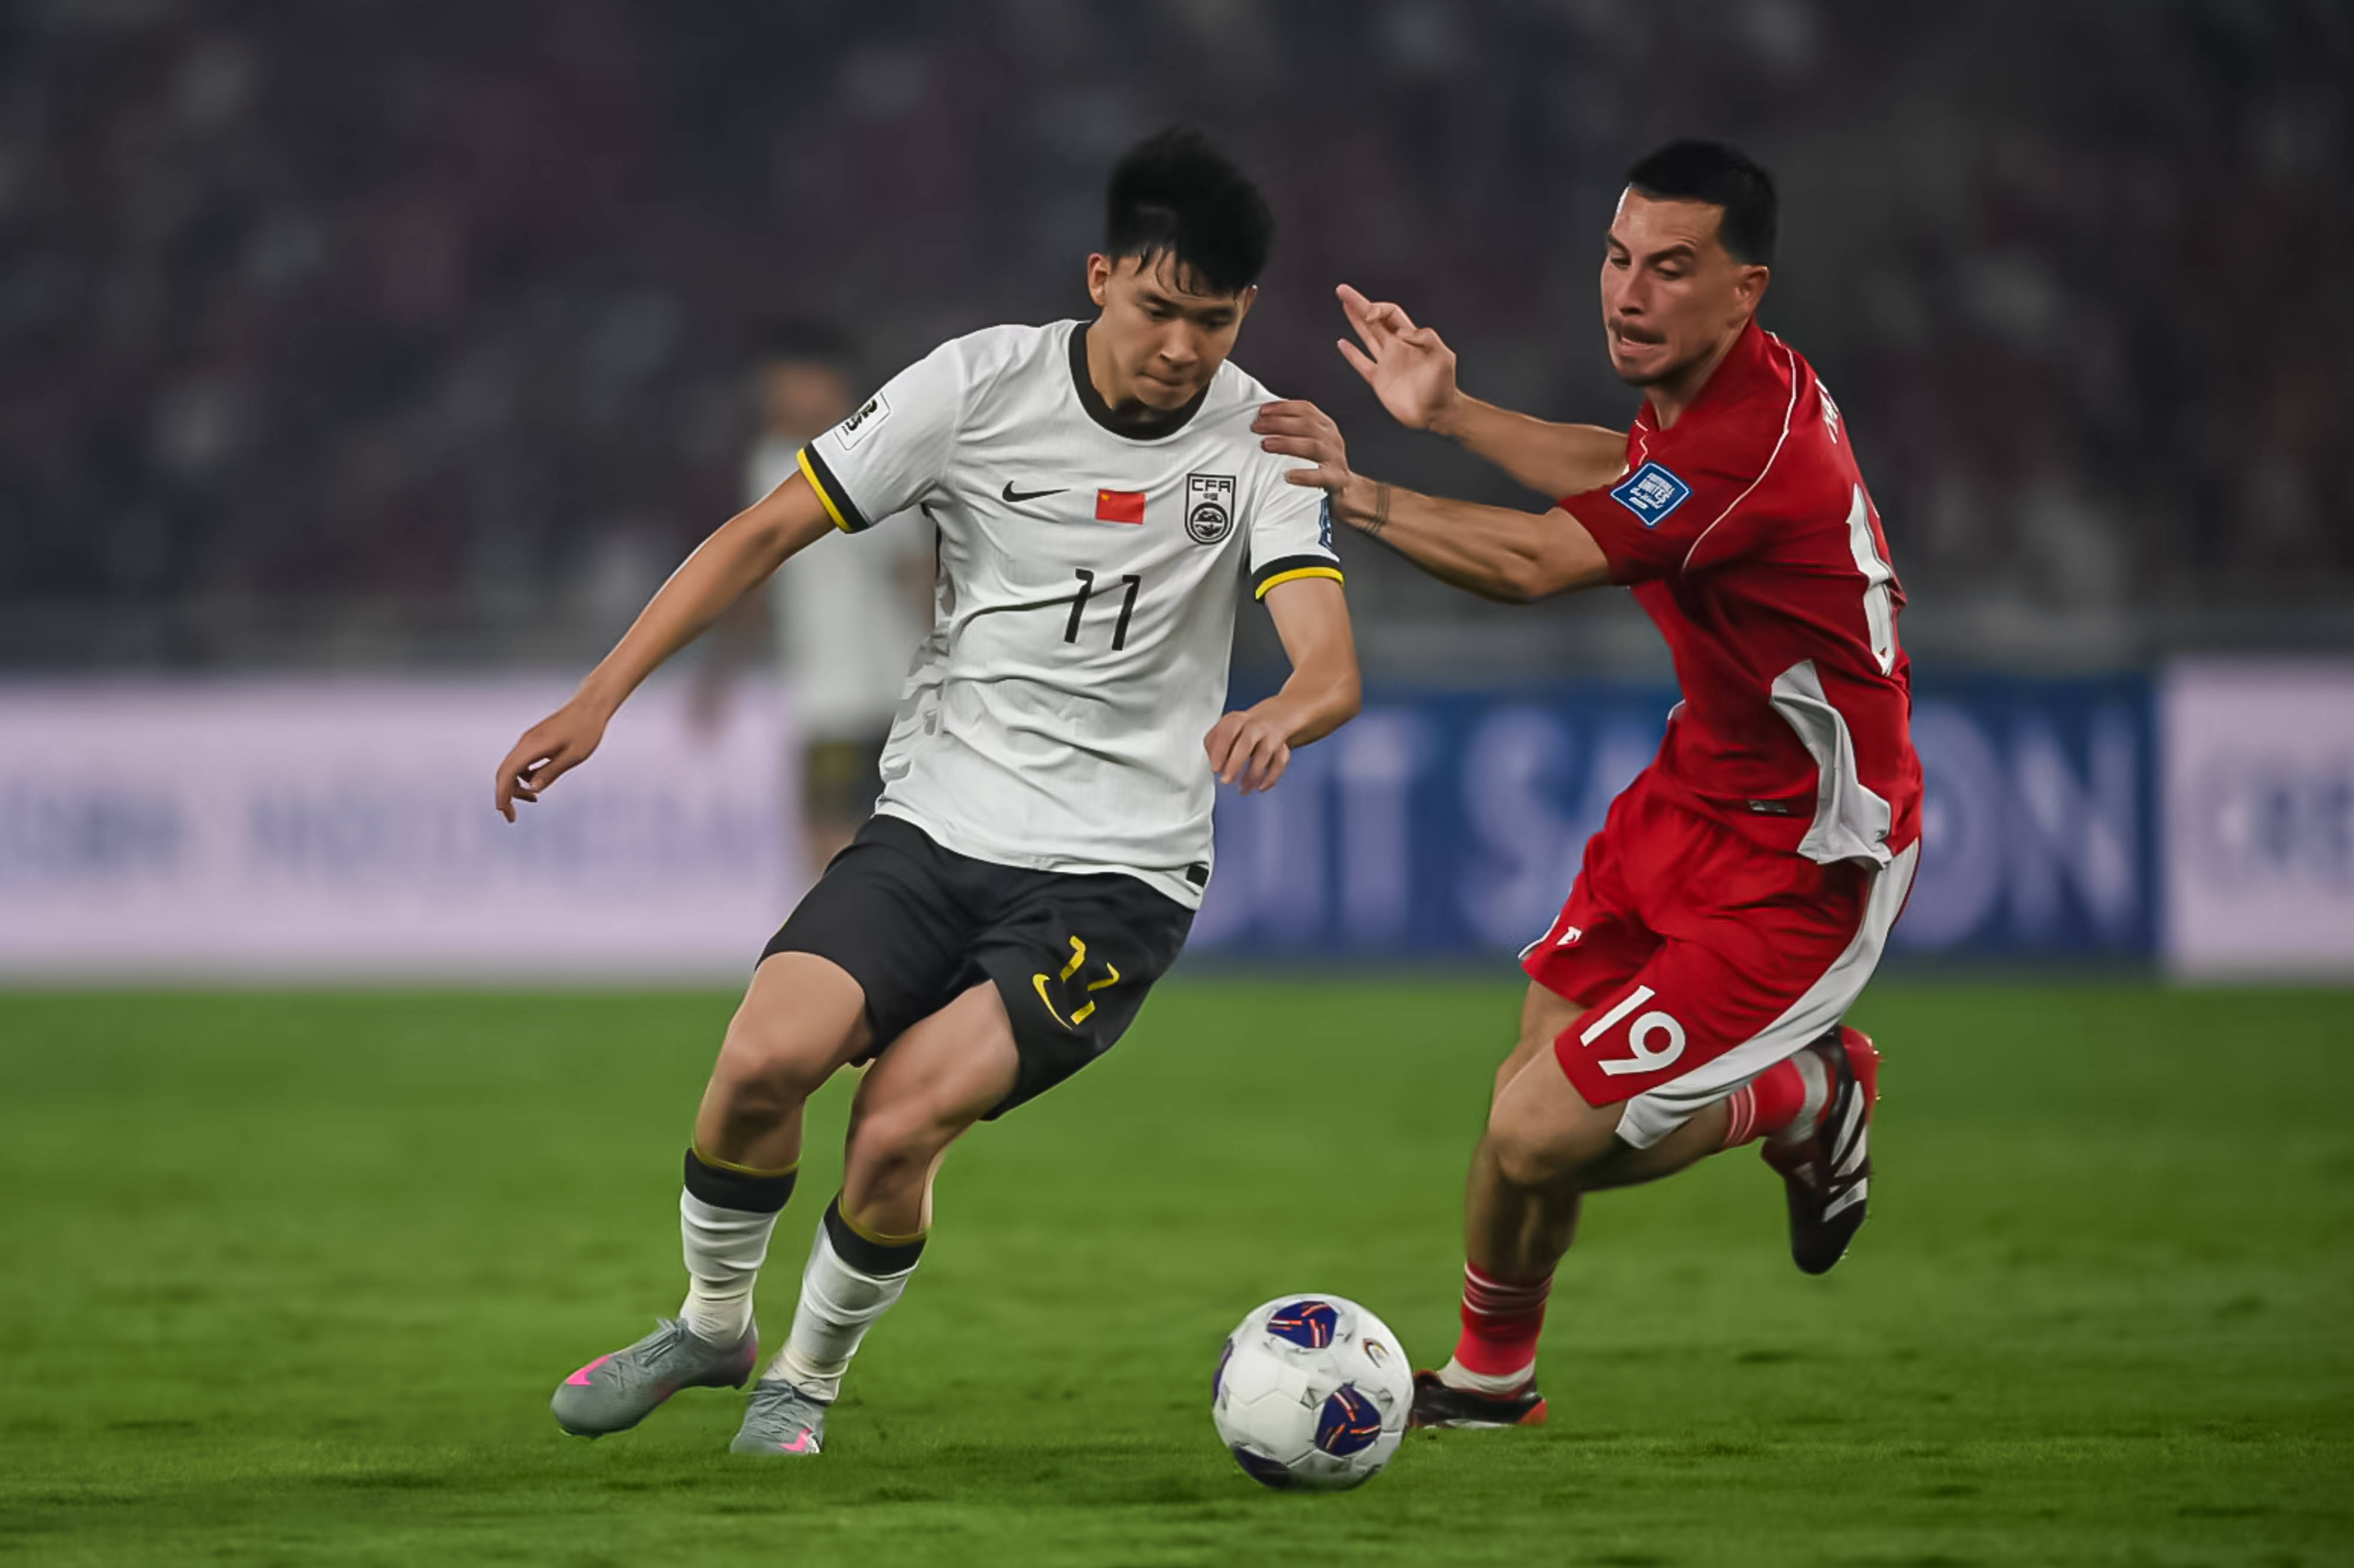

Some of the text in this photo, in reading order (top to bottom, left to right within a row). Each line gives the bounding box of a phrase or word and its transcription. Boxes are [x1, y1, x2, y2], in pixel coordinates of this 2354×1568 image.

[1192, 478, 1231, 493] CFA
[1063, 568, 1142, 651] 11
[1580, 985, 1686, 1076] 19
